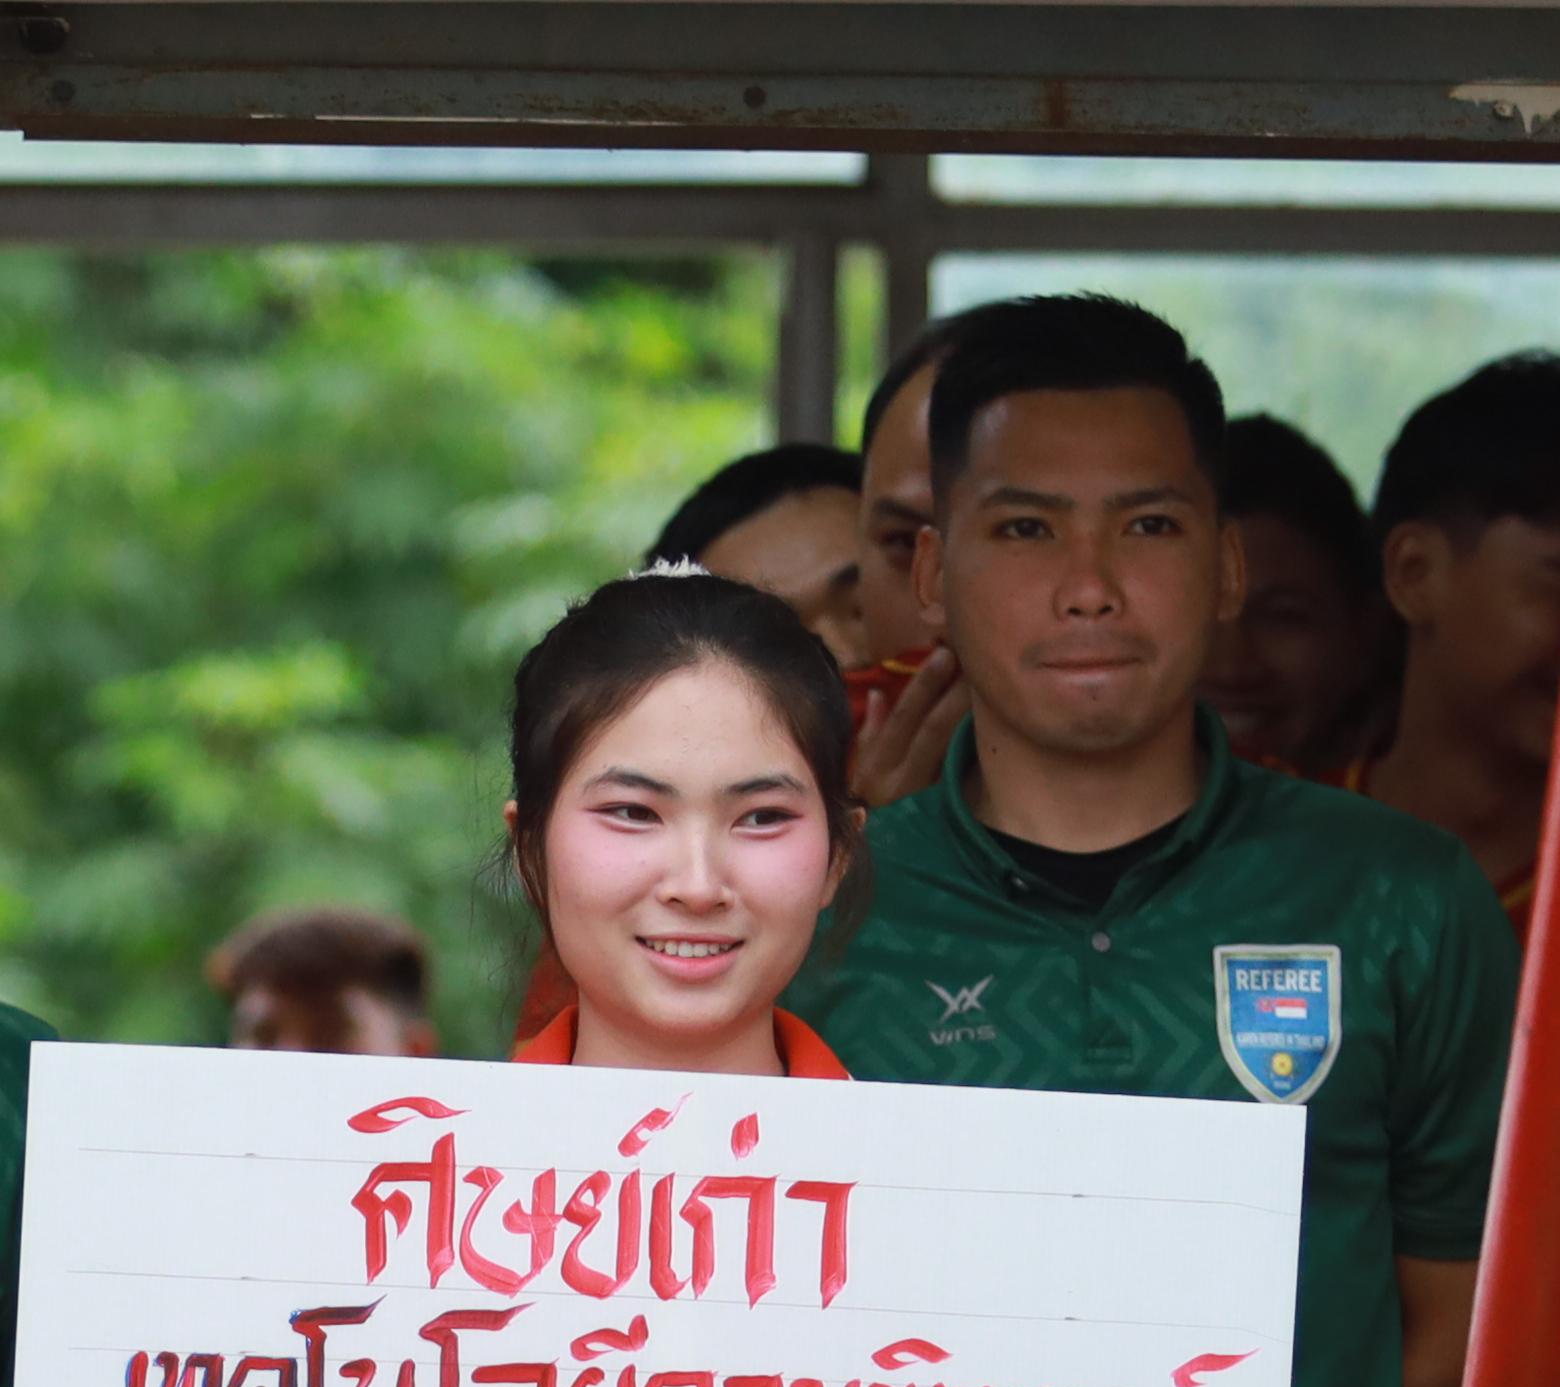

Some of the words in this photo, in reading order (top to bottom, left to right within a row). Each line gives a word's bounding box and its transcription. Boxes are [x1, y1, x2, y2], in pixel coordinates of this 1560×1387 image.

[1236, 969, 1322, 992] REFEREE
[347, 1091, 858, 1309] ศิษย์เก่า
